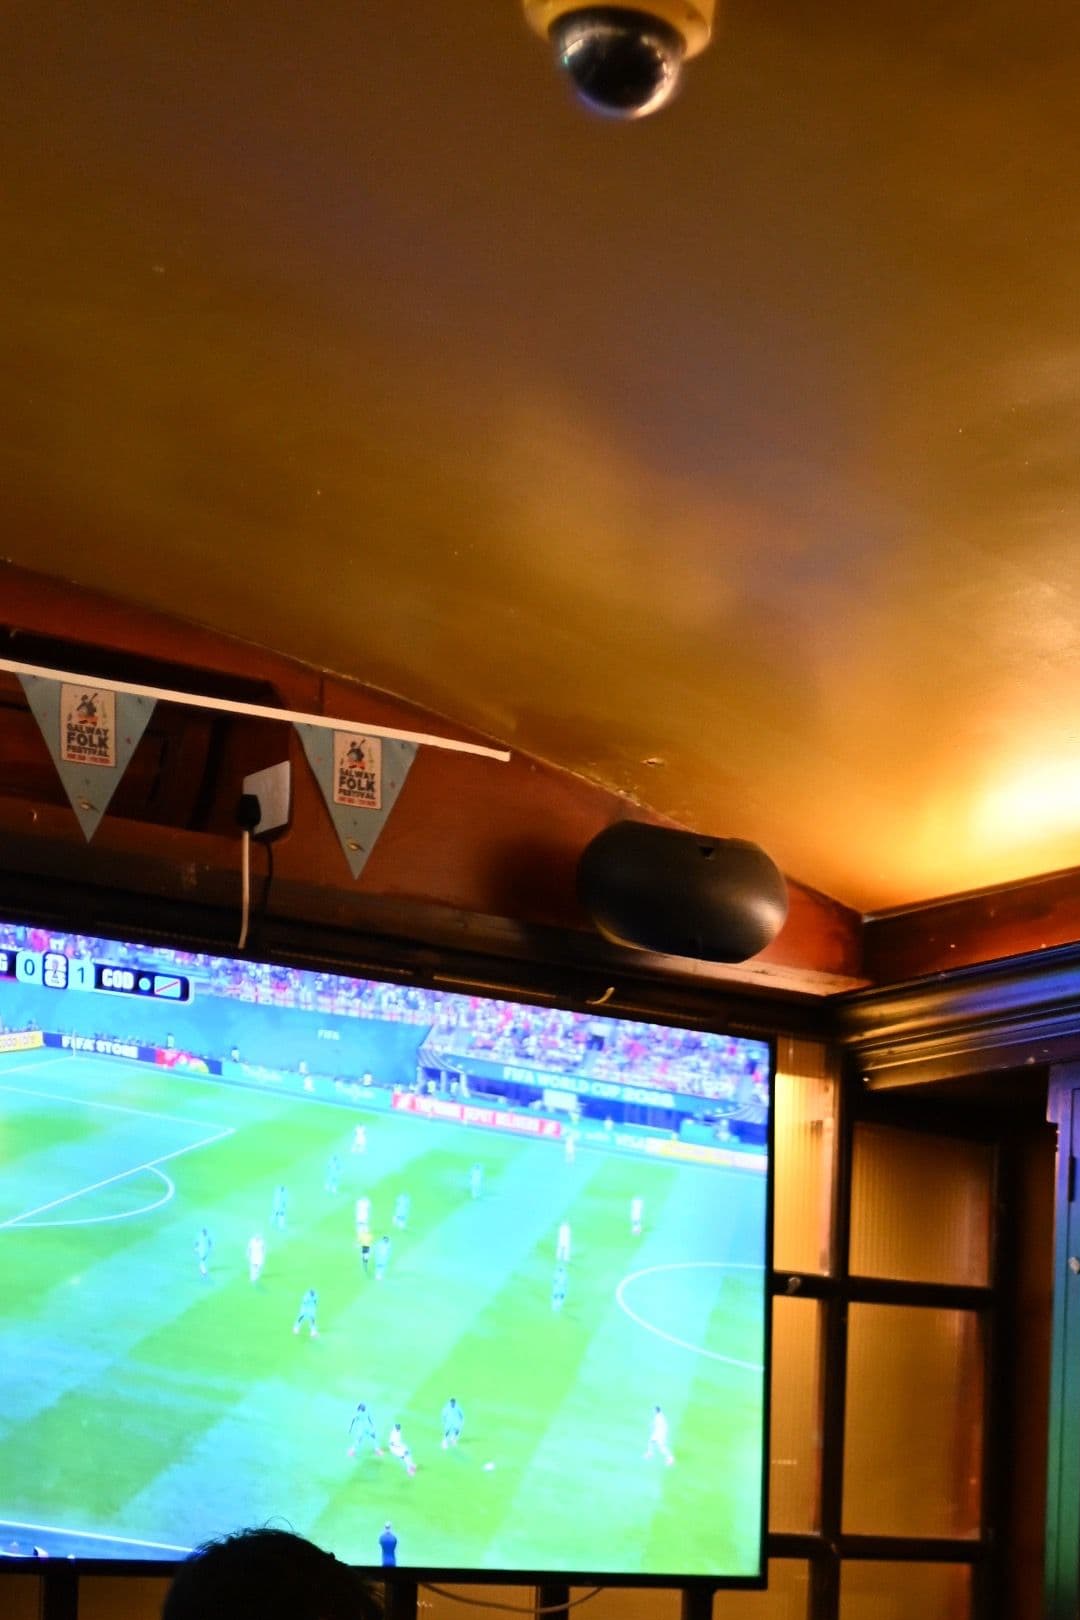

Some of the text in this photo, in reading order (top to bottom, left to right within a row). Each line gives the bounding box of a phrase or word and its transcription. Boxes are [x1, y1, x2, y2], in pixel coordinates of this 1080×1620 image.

[67, 731, 109, 750] FOLK
[339, 776, 375, 792] FOLK
[102, 968, 134, 990] COD
